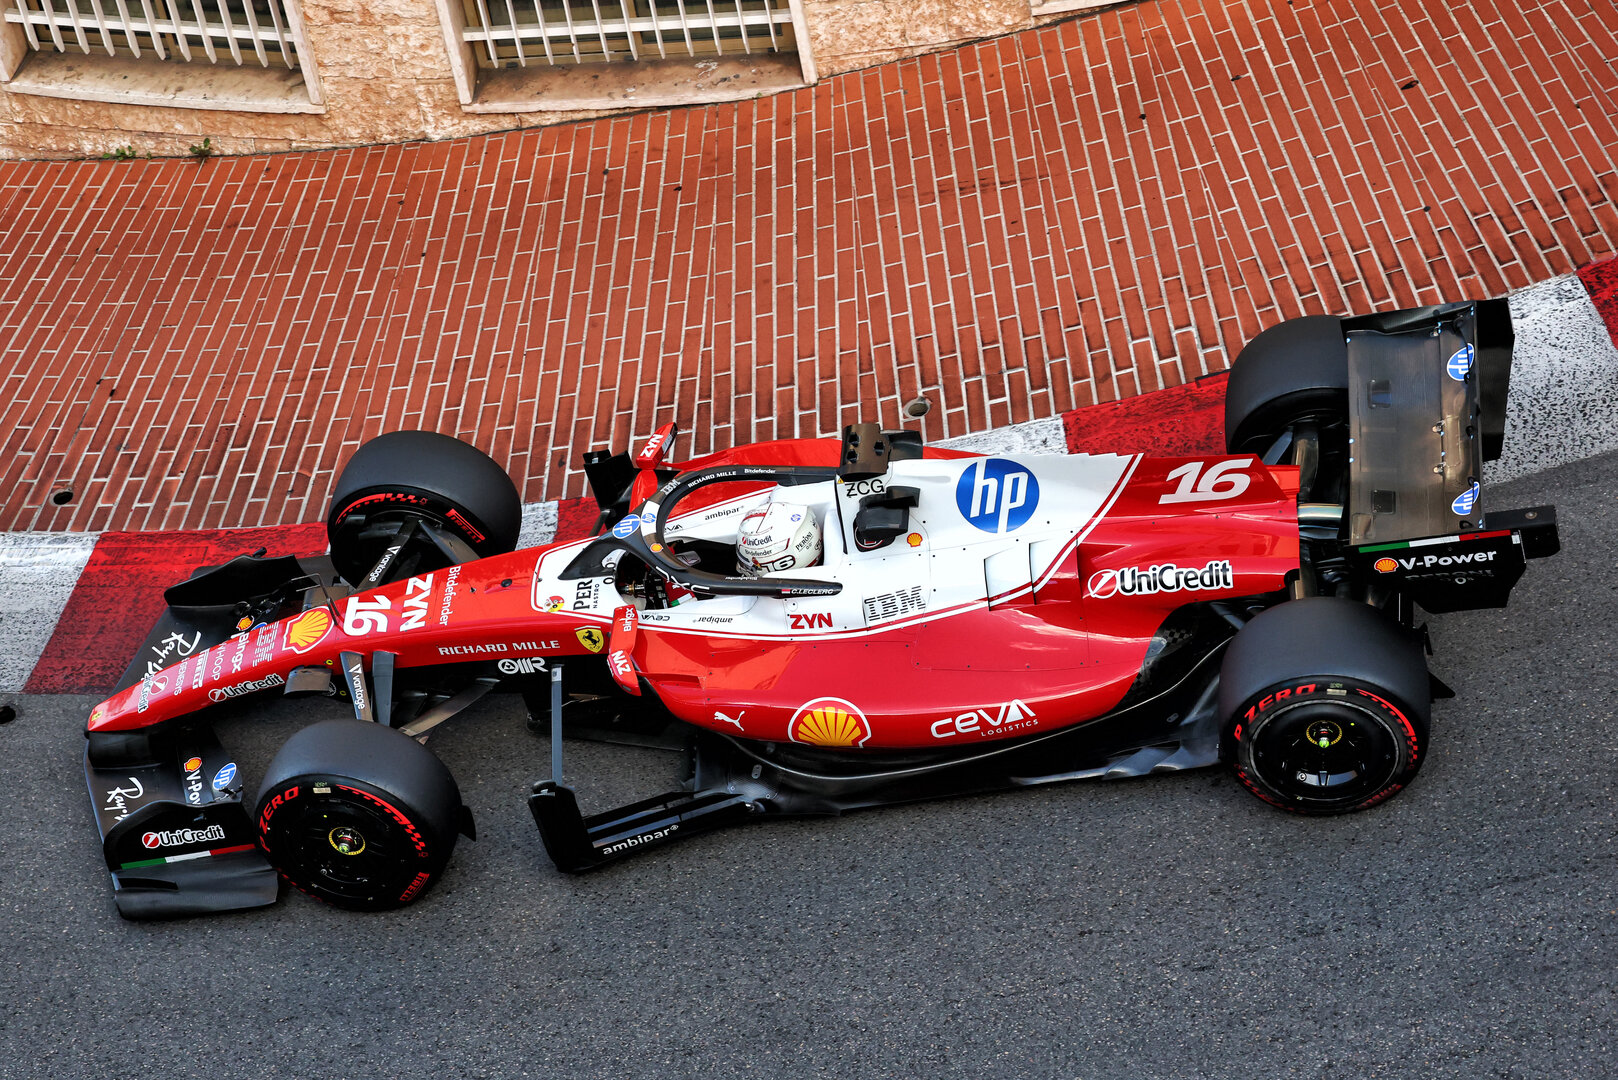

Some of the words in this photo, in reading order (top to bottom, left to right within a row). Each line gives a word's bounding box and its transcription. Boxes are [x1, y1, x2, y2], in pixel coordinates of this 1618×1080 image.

[640, 434, 664, 458] ZYN
[687, 475, 715, 488] RICHARD
[1158, 458, 1253, 505] 16
[956, 458, 1039, 534] hp
[747, 535, 773, 547] UniCredit
[369, 554, 391, 582] vantage
[759, 555, 796, 573] 16
[1399, 551, 1497, 570] V-Power
[1118, 560, 1233, 596] UniCredit
[400, 573, 434, 632] ZYN
[439, 566, 461, 626] Bitdefender
[573, 579, 593, 611] PER
[864, 586, 926, 622] IBM
[343, 595, 392, 636] 16
[790, 613, 833, 630] ZYN
[439, 643, 508, 656] RICHARD
[512, 640, 561, 651] MILLE
[611, 650, 632, 675] ZYN
[222, 673, 285, 698] UniCredit
[351, 672, 366, 710] vantage
[1243, 683, 1317, 724] ZERO
[981, 719, 1039, 737] LOGISTICS
[212, 763, 237, 790] hp
[259, 786, 299, 835] ZERO
[158, 825, 225, 847] UniCredit
[400, 871, 431, 901] PIRELLI
